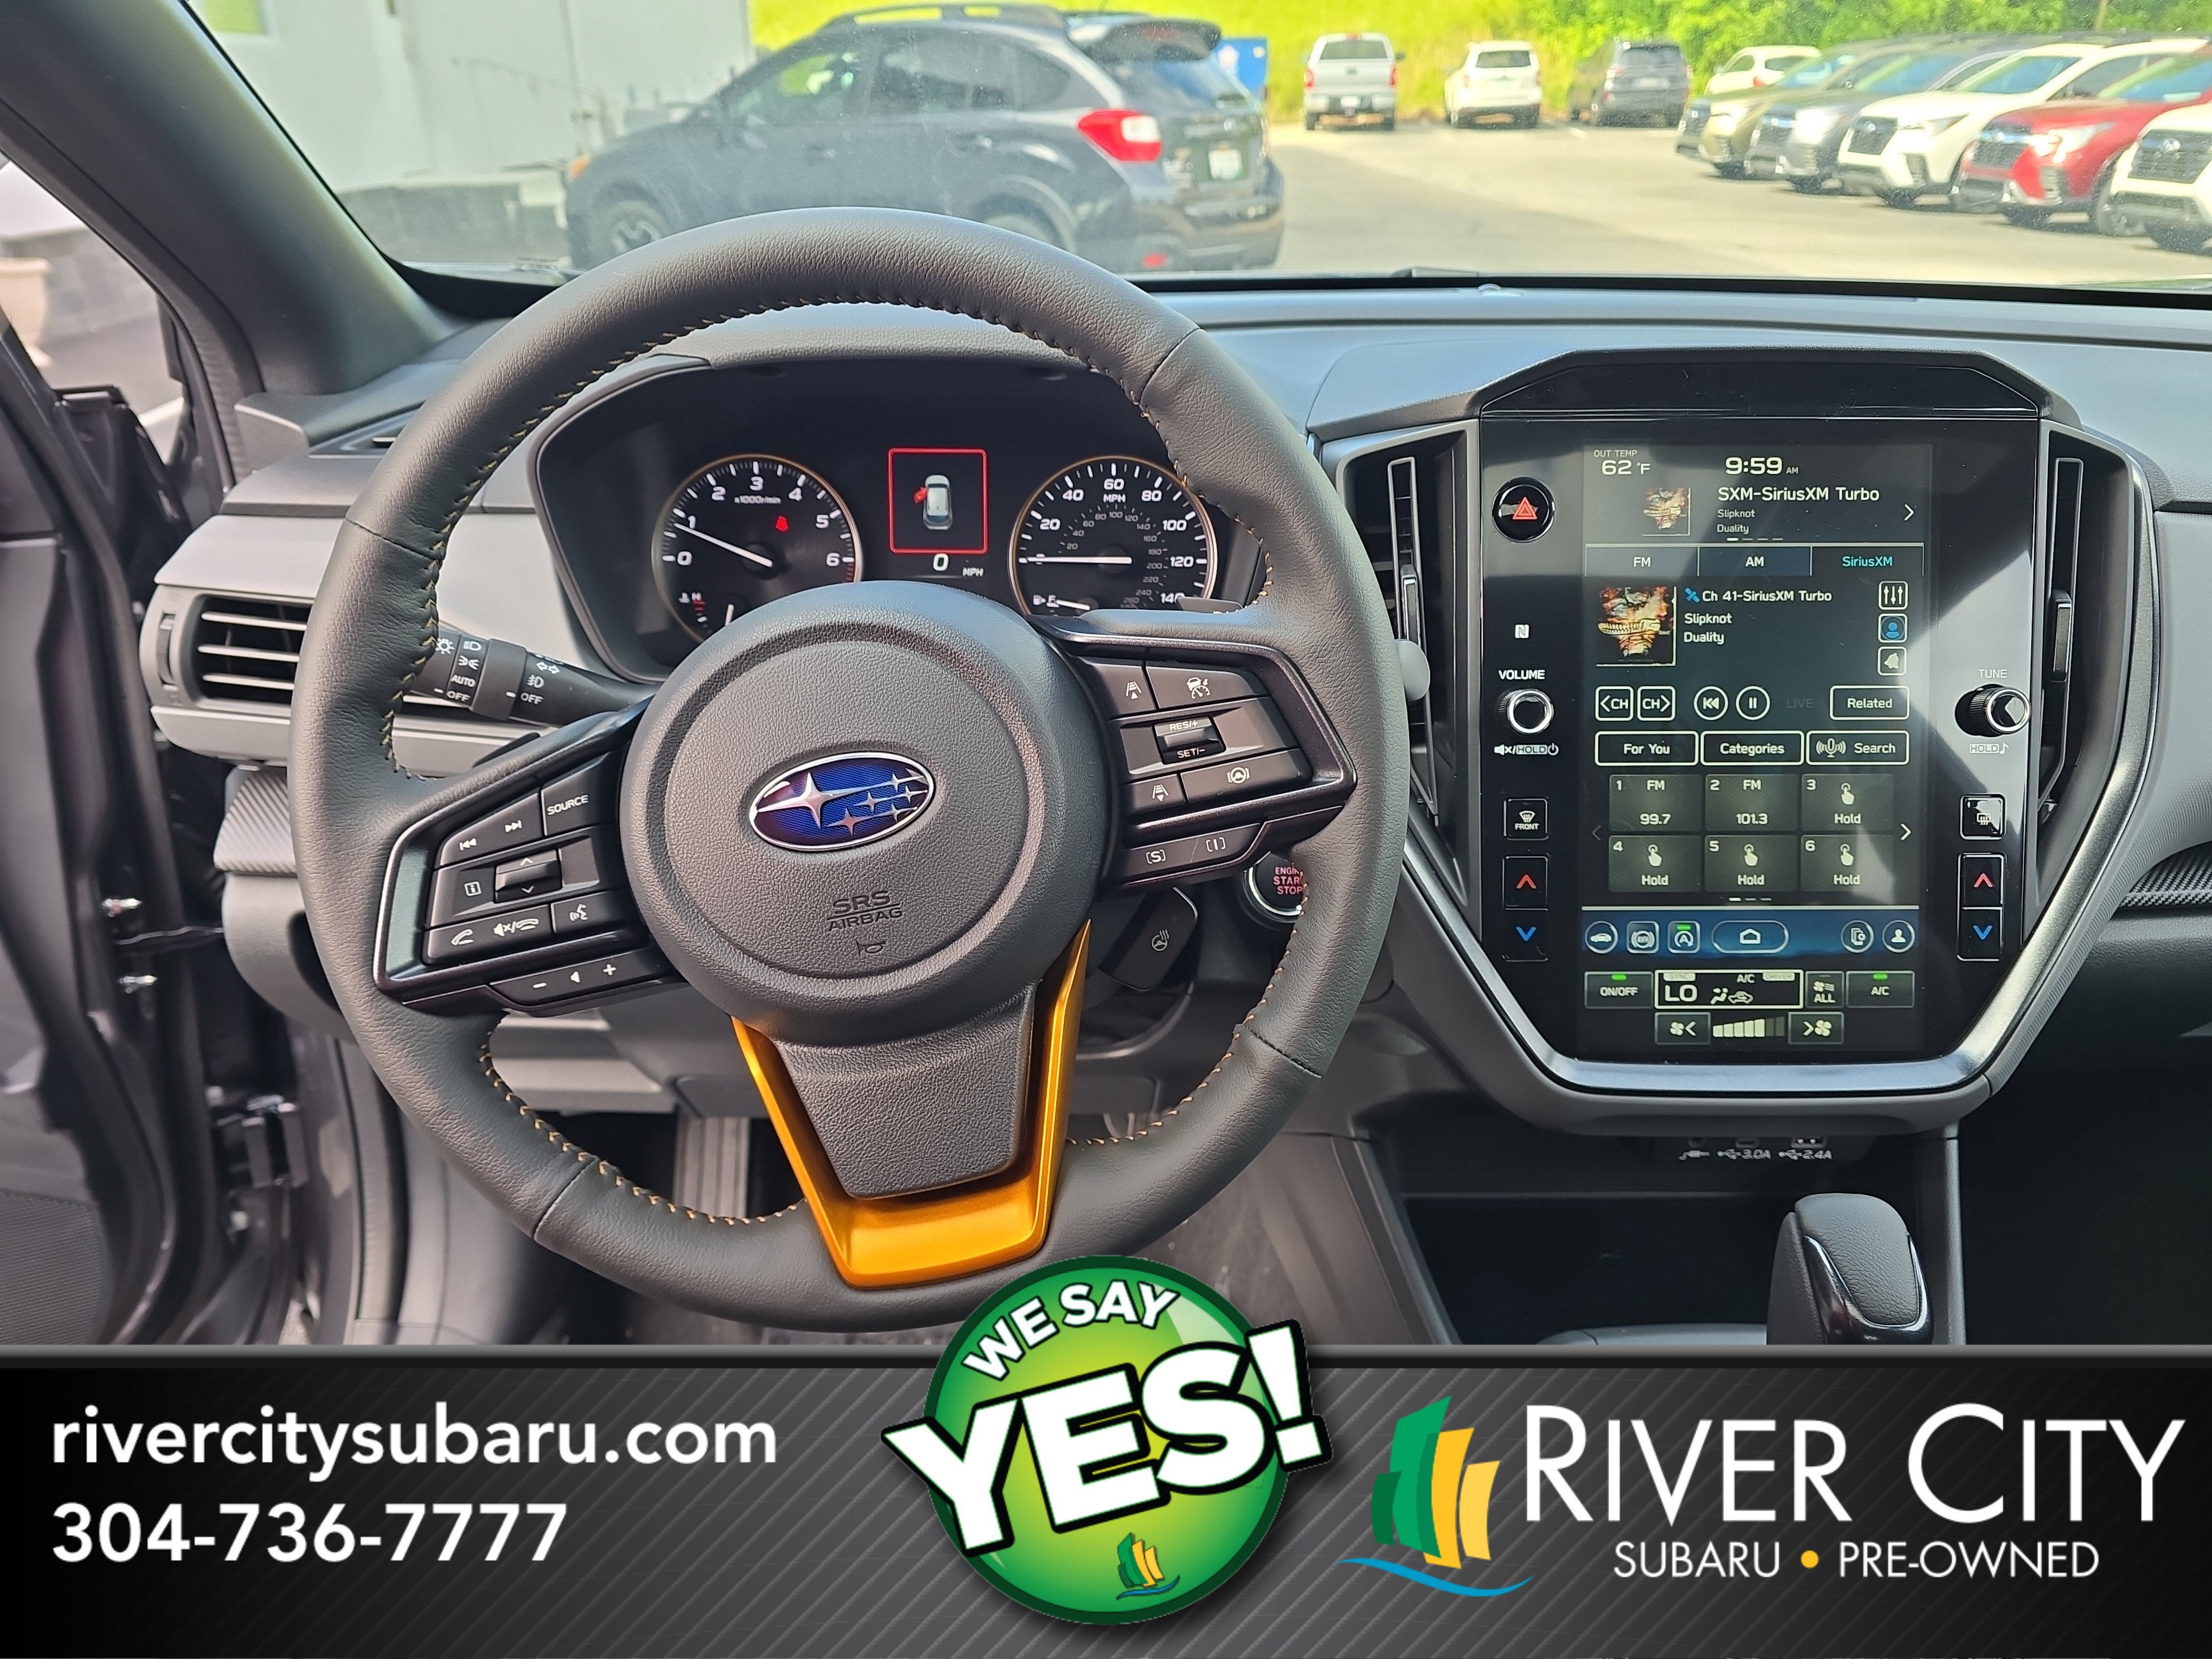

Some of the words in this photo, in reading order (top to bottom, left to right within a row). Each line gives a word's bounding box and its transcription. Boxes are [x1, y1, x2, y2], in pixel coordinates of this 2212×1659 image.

[1601, 460, 1632, 475] 62
[1725, 456, 1783, 475] 9:59
[749, 476, 764, 491] 3
[1103, 478, 1125, 491] 60
[711, 486, 726, 501] 2
[788, 487, 803, 501] 4
[1062, 488, 1085, 501] 40
[1103, 493, 1127, 503] MPH
[1141, 490, 1163, 502] 80
[1717, 486, 1829, 501] SXM-SiriusXM
[1835, 486, 1880, 501] Turbo
[1095, 513, 1107, 521] 80
[1109, 511, 1124, 519] 100
[1124, 514, 1139, 522] 120
[1716, 509, 1756, 520] Slipknot
[687, 515, 697, 529] 1
[815, 513, 830, 529] 5
[1039, 518, 1061, 531] 20
[1082, 520, 1095, 528] 60
[1162, 519, 1188, 531] 100
[1716, 523, 1750, 535] Duality
[677, 550, 693, 566] 0
[826, 552, 841, 567] 6
[933, 553, 949, 571] 0
[1169, 556, 1194, 568] 120
[1633, 557, 1651, 568] FM
[1745, 557, 1765, 568] AM
[1841, 555, 1893, 568] SiriusXM
[962, 567, 984, 577] MPH
[1702, 590, 1718, 602] Ch
[1722, 590, 1795, 602] 41-SiriusXM
[1798, 590, 1832, 602] Turbo
[1684, 612, 1733, 626] Slipknot
[1683, 631, 1725, 645] Duality
[1498, 670, 1546, 681] VOLUME
[1978, 668, 2008, 679] TUNE
[450, 674, 476, 687] AUTO
[446, 690, 471, 702] OFF
[520, 692, 544, 705] OFF
[1786, 698, 1814, 709] LIVE
[1847, 697, 1893, 709] Related
[1517, 745, 1547, 755] HOLD
[1623, 743, 1645, 755] For
[1648, 743, 1671, 755] You
[1719, 743, 1785, 756] Categories
[1853, 742, 1896, 754] Search
[1970, 744, 1999, 754] HOLD
[1616, 780, 1623, 791] 1
[1646, 780, 1666, 791] FM
[1709, 780, 1720, 791] 2
[1742, 780, 1762, 791] FM
[1806, 779, 1817, 791] 3
[546, 794, 589, 815] SOURCE
[1639, 813, 1672, 826] 99.7
[1735, 813, 1769, 826] 101.3
[1834, 813, 1861, 825] Hold
[1612, 841, 1624, 852] 4
[1708, 841, 1720, 853] 5
[1805, 840, 1816, 852] 6
[1275, 866, 1300, 875] ENGIN
[1273, 876, 1300, 885] STAR
[1641, 874, 1669, 886] Hold
[1737, 874, 1765, 886] Hold
[1833, 874, 1861, 886] Hold
[1277, 885, 1303, 895] STOP
[833, 890, 891, 914] SRS
[828, 907, 903, 932] AIRBAG
[1737, 974, 1756, 983] A/C
[1599, 986, 1639, 998] ON/OFF
[1664, 984, 1698, 1002] LO
[1870, 986, 1890, 996] A/C
[1813, 993, 1836, 1004] ALL
[1802, 1149, 1832, 1160] 2.4A
